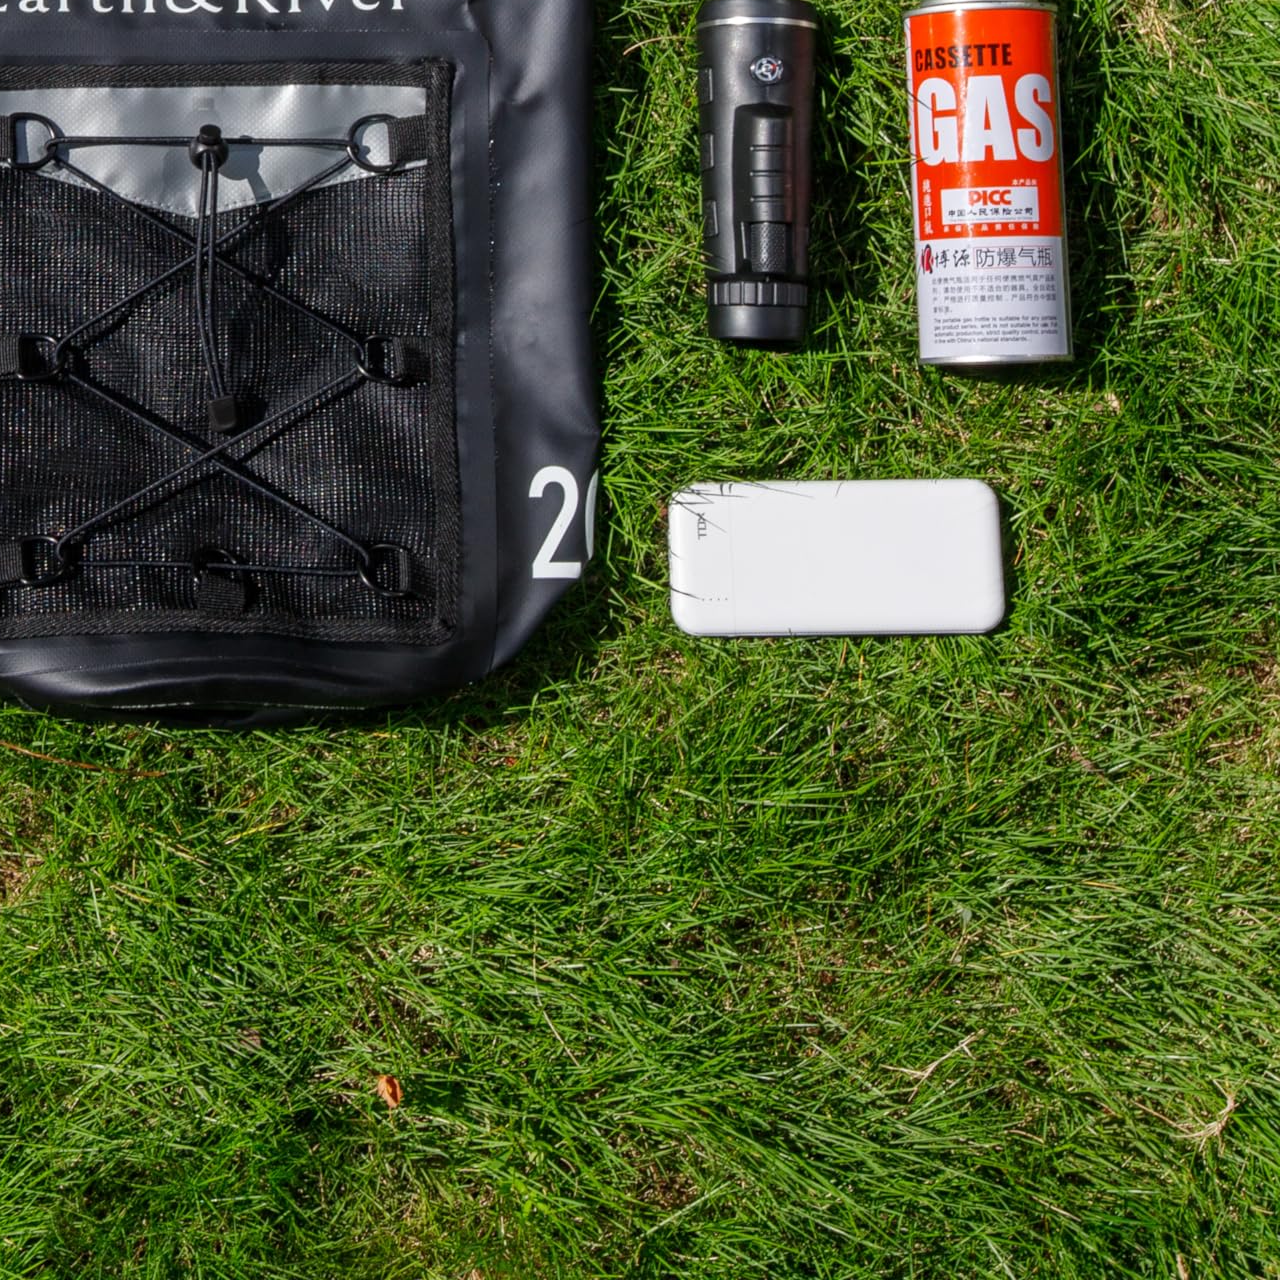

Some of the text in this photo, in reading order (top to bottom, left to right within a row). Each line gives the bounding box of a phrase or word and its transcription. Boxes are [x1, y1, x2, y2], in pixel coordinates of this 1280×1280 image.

[915, 43, 1013, 73] CASSETTE
[916, 73, 1055, 167] GAS
[968, 189, 1012, 207] PICC
[948, 207, 1033, 217] 中国人民保险公司
[975, 247, 1053, 268] 防爆气瓶
